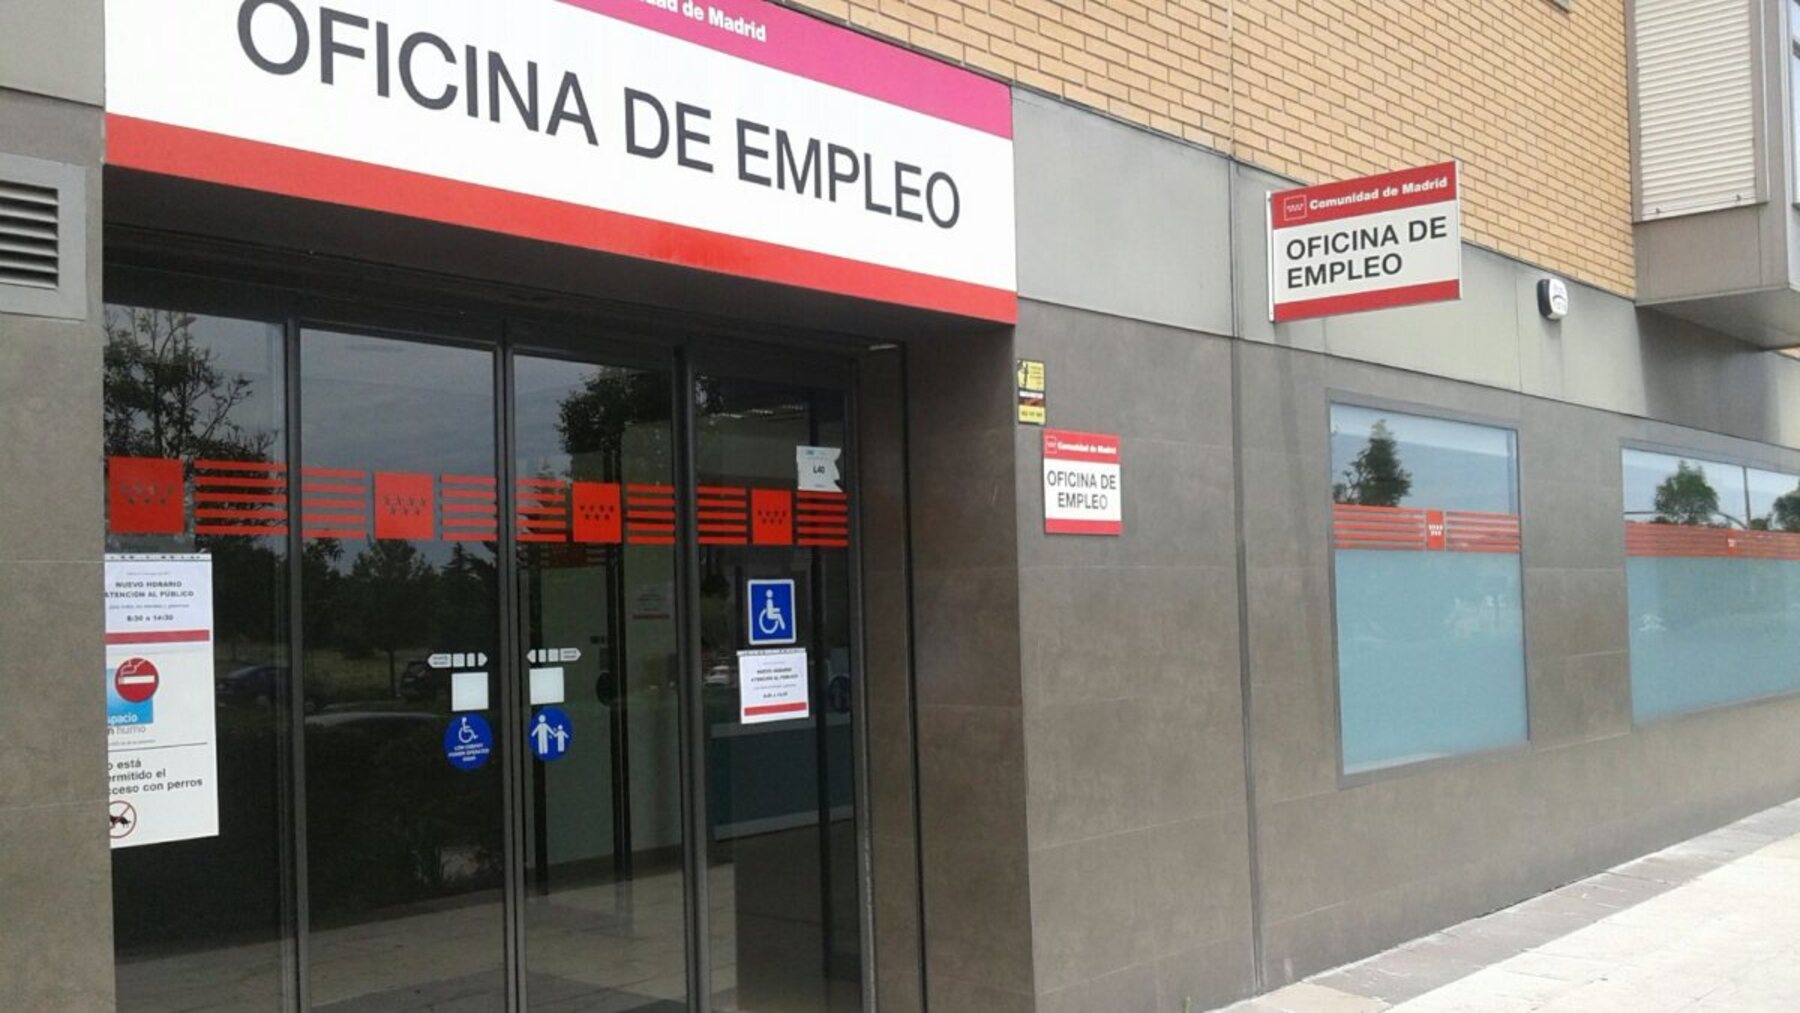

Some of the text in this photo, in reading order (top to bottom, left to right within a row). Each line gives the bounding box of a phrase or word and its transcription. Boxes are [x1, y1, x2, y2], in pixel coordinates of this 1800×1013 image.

[682, 0, 705, 20] de
[708, 6, 766, 42] Madrid
[237, 0, 960, 230] OFICINA DE EMPLEO
[1309, 176, 1448, 211] Comunidad de Madrid
[1286, 215, 1447, 261] OFICINA DE
[1287, 252, 1403, 290] EMPLEO
[1047, 469, 1117, 490] OFICINA DE
[1057, 491, 1108, 510] EMPLEO
[146, 580, 182, 588] HORARIO
[148, 590, 158, 598] AL
[117, 757, 142, 769] está
[156, 767, 166, 778] el
[143, 782, 164, 792] con
[167, 778, 203, 791] perros
